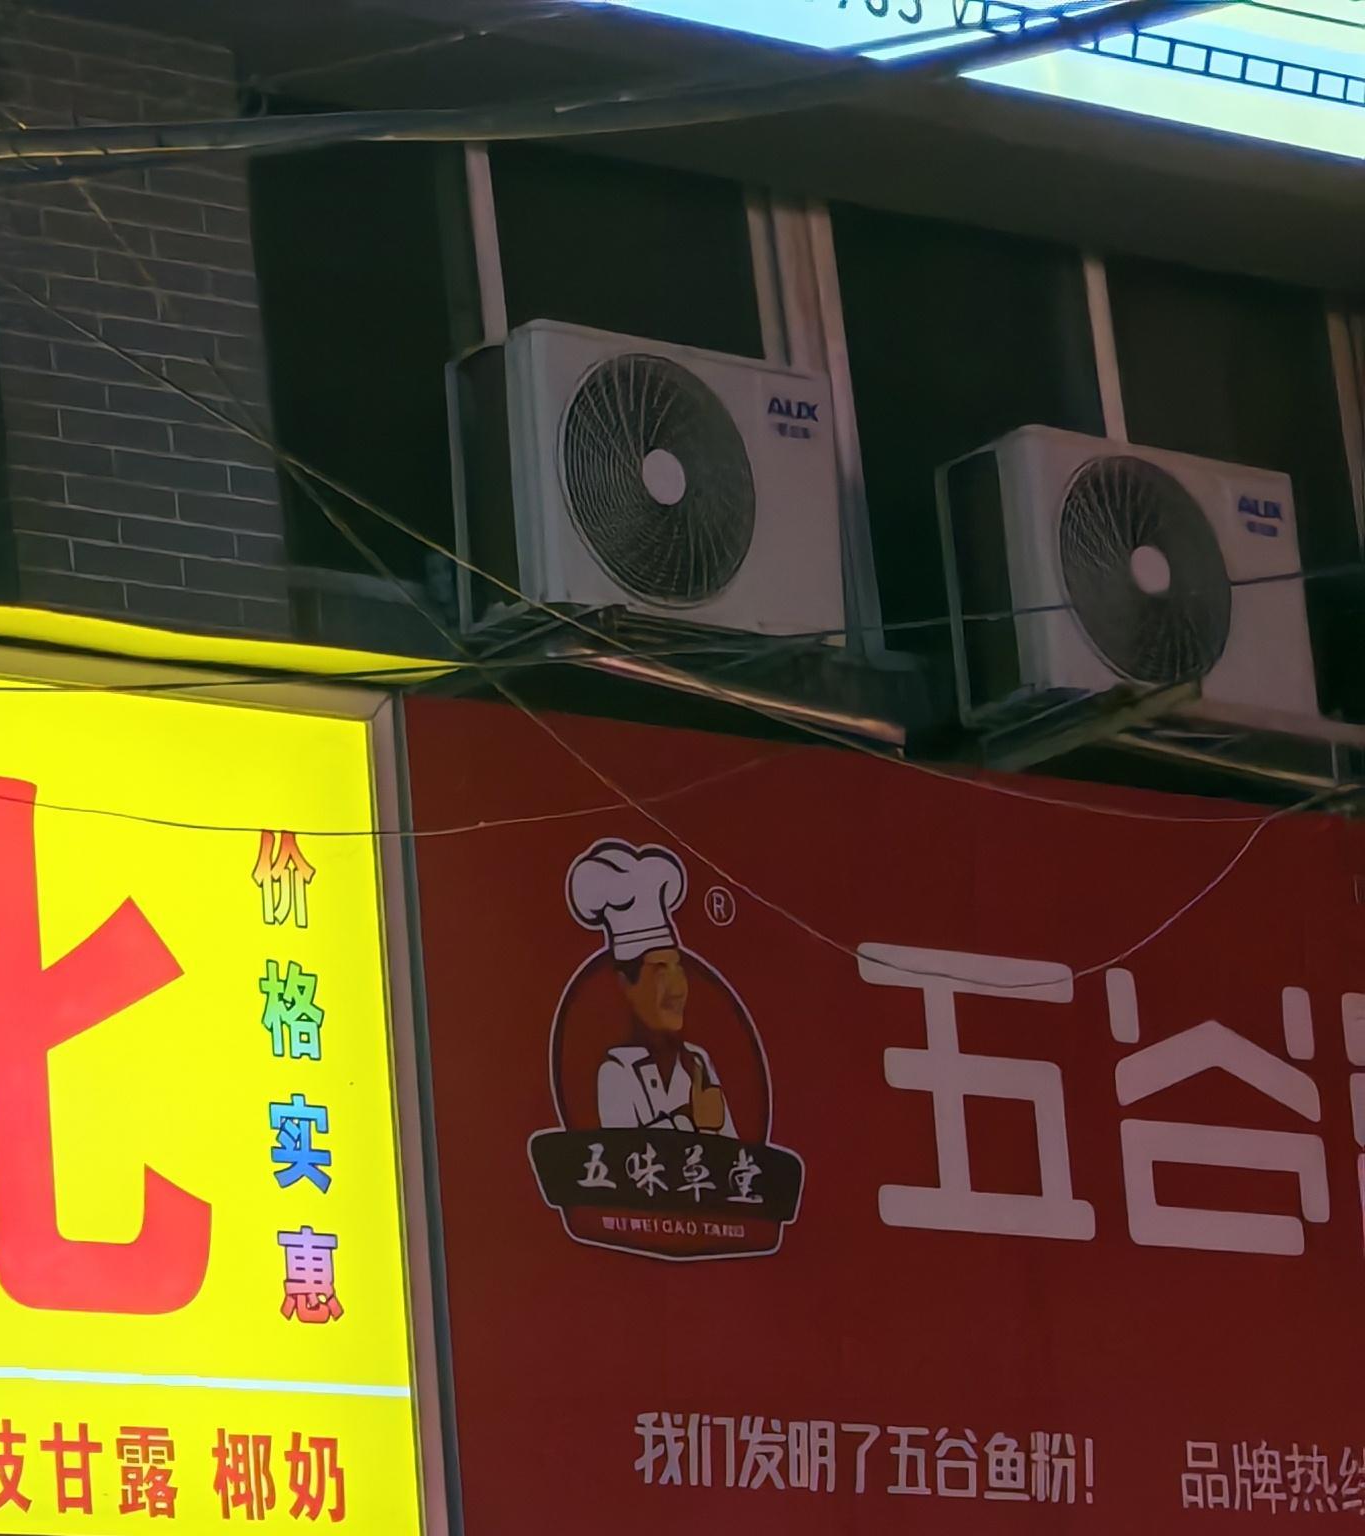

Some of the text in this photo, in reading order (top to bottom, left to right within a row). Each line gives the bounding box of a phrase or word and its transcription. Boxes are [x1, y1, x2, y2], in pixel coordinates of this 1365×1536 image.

[768, 397, 819, 422] AUX
[252, 827, 344, 1324] 价格实惠
[857, 942, 1365, 1262] 五谷
[577, 1142, 763, 1203] 五味草堂
[214, 1428, 346, 1524] 椰奶
